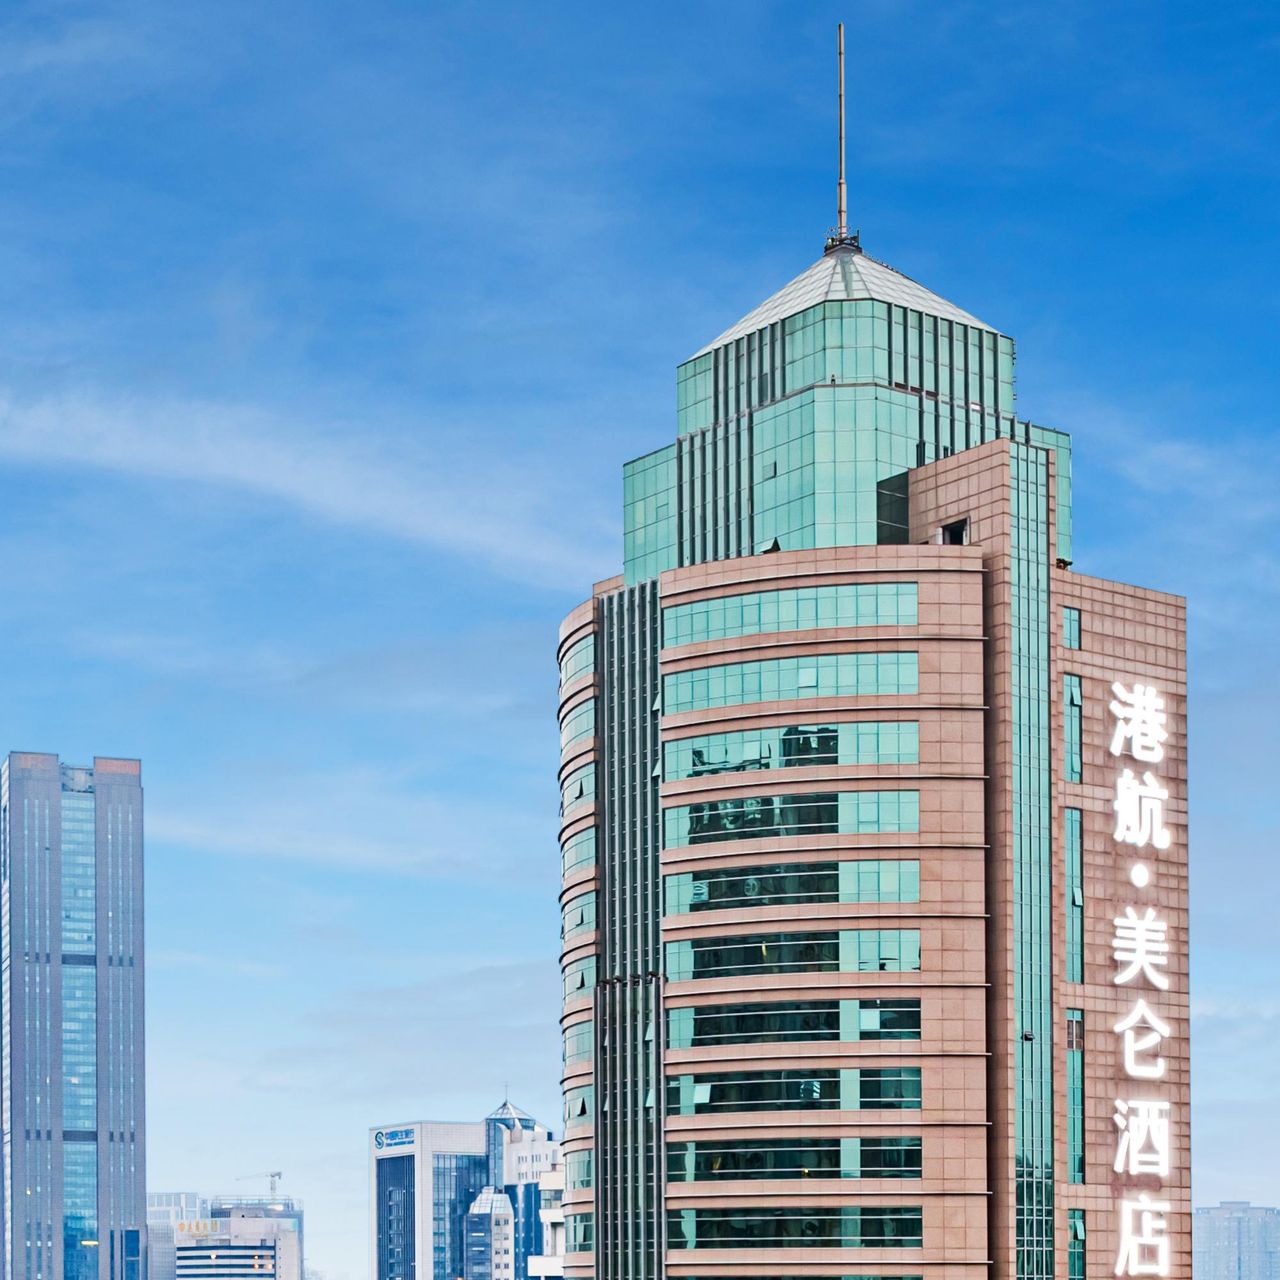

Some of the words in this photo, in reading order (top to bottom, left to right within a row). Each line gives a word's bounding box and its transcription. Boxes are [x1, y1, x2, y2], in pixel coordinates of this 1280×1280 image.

[1109, 680, 1171, 1278] 港航·美仑酒店
